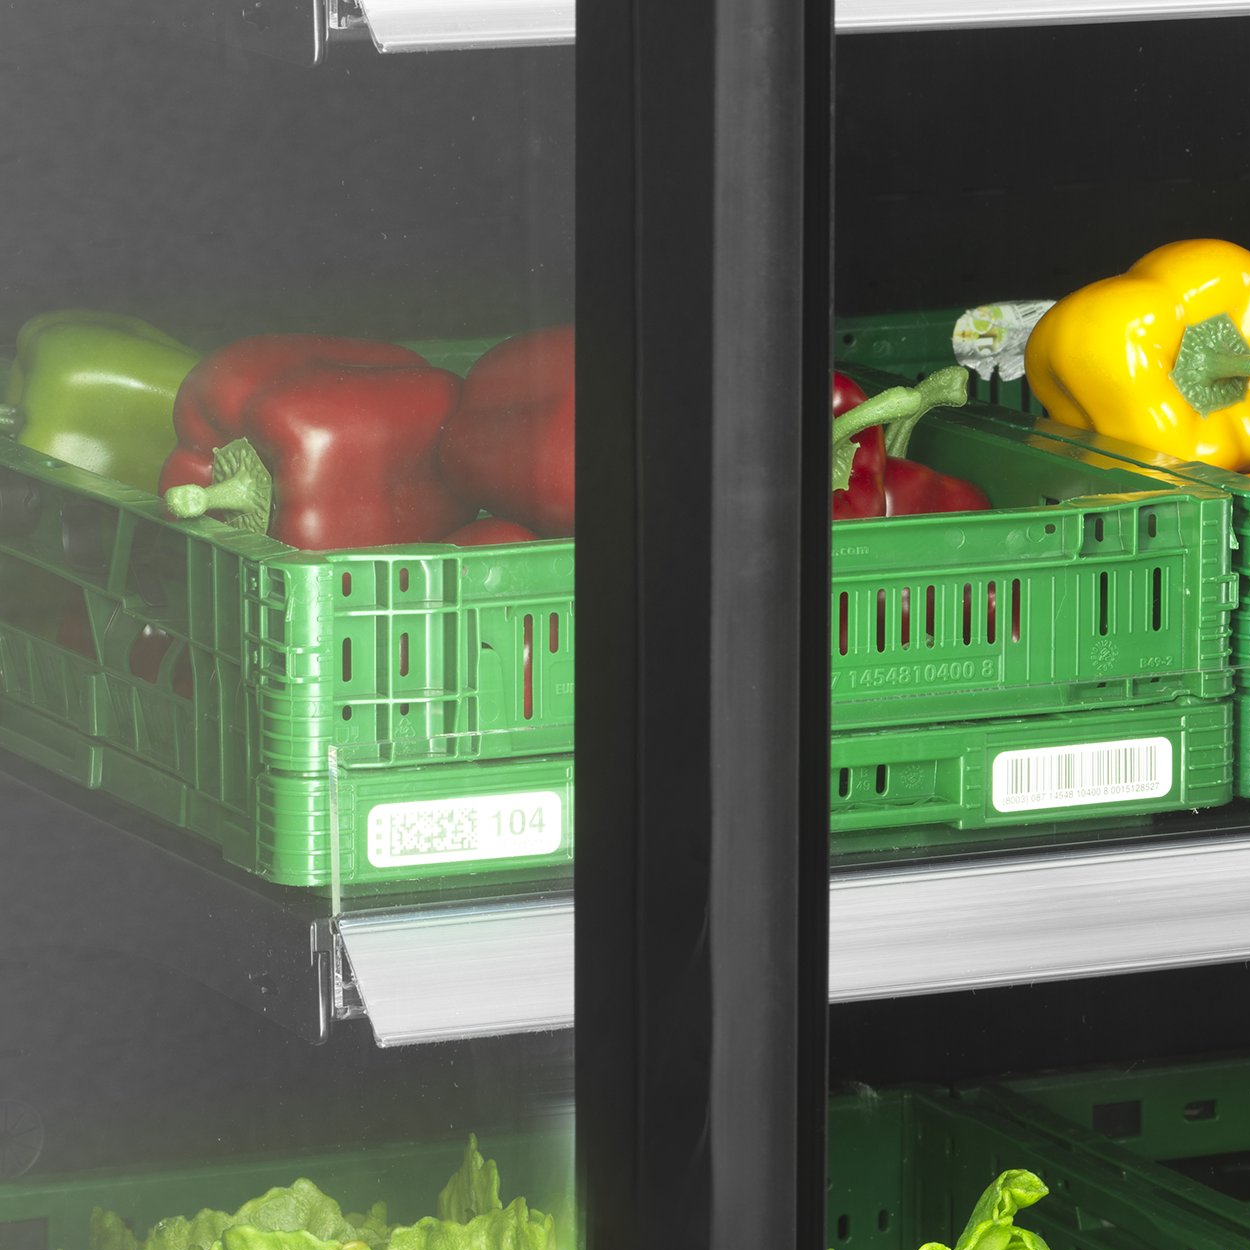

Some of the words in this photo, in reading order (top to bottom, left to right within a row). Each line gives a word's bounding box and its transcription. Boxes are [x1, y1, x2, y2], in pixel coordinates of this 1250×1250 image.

[848, 660, 976, 689] 1454810400
[981, 658, 995, 679] 8
[1139, 654, 1174, 669] B49-2
[1002, 794, 1029, 807] (8003)
[1030, 792, 1046, 803] 087
[1049, 790, 1074, 800] 14548
[1077, 787, 1102, 798] 10400
[1103, 786, 1109, 796] 8
[1110, 781, 1160, 795] 0015128527
[490, 806, 546, 838] 104
